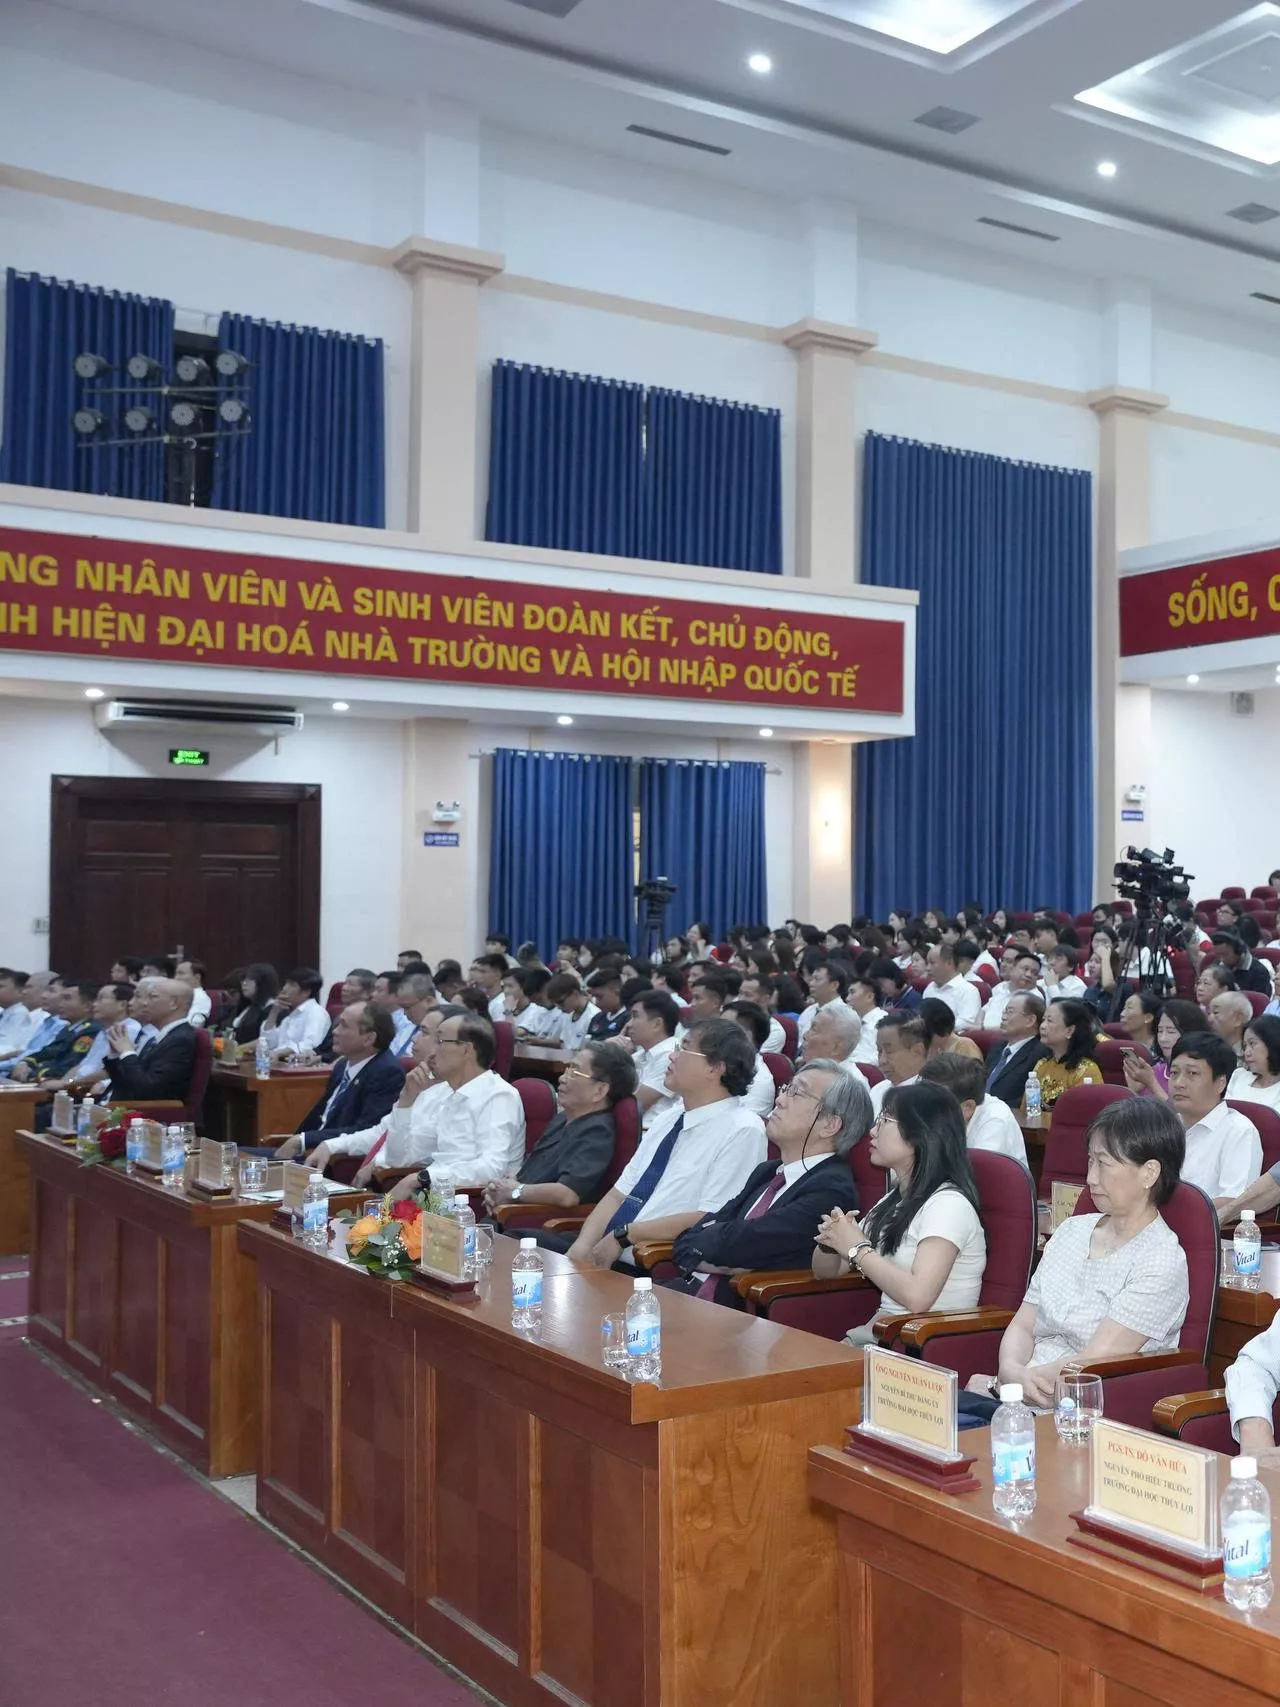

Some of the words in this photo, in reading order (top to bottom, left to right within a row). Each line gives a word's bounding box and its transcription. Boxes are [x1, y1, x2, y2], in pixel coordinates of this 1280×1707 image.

[0, 552, 57, 585] NG
[77, 560, 189, 598] NHÂN
[203, 570, 286, 607] VIÊN
[299, 577, 341, 612] VÀ
[354, 588, 430, 619] SINH
[443, 593, 513, 627] VIÊN
[523, 601, 610, 636] ĐOÀN
[621, 605, 677, 645] KẾT,
[689, 613, 746, 648] CHỦ
[754, 622, 837, 659] ĐỘNG,
[1169, 572, 1256, 626] SỐNG,
[53, 602, 144, 648] HIỆN
[158, 616, 224, 654] ĐẠI
[238, 622, 313, 655] HOÁ
[326, 627, 397, 661] NHÀ
[409, 634, 540, 673] TRƯỜNG
[551, 646, 592, 676] VÀ
[603, 653, 650, 687] HỘI
[659, 655, 737, 692] NHẬP
[744, 660, 820, 695] QUỐC
[828, 663, 860, 697] TẾ
[1236, 1252, 1256, 1266] Vital
[1144, 1490, 1158, 1502] HỌC
